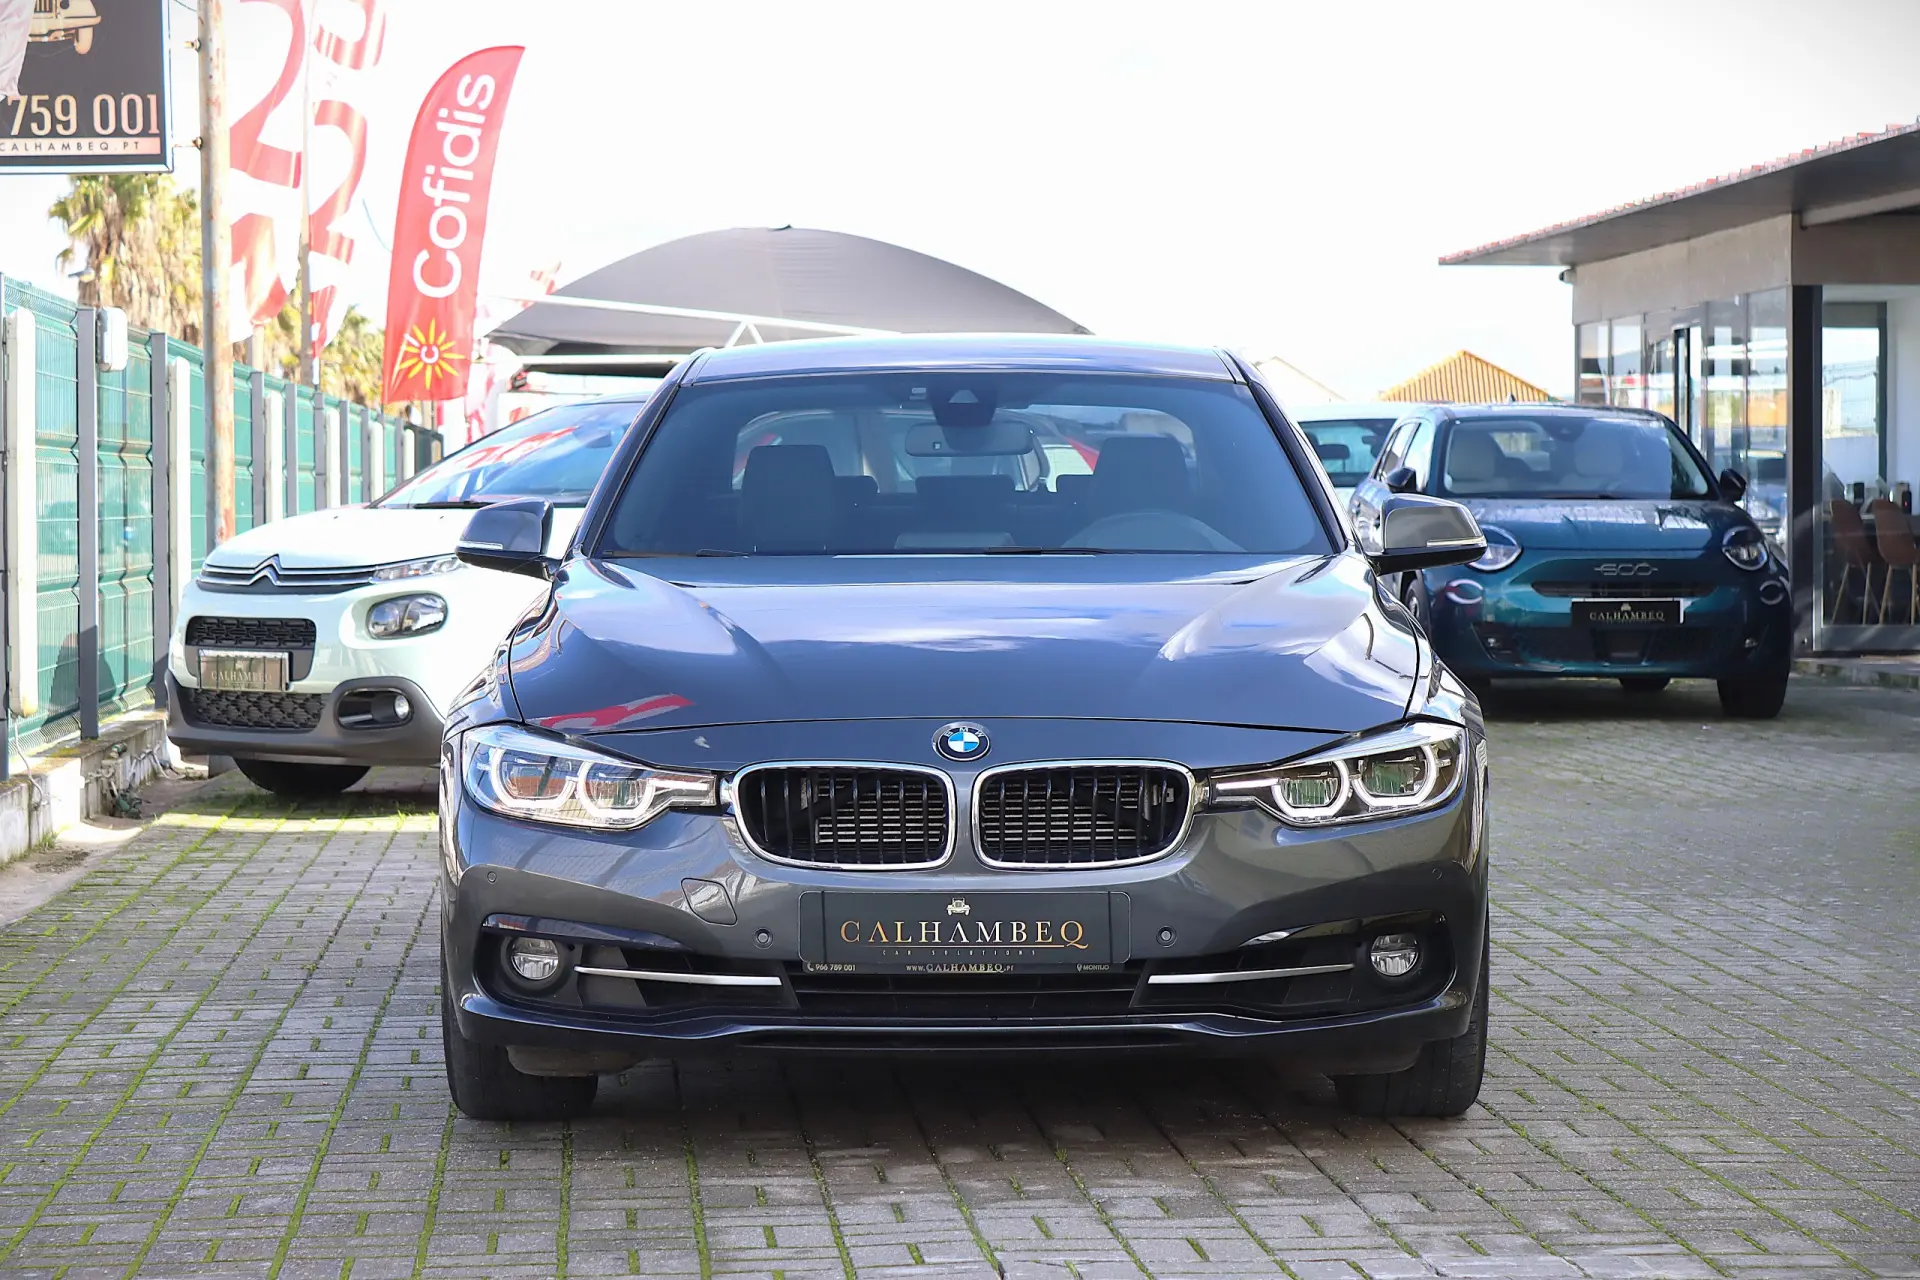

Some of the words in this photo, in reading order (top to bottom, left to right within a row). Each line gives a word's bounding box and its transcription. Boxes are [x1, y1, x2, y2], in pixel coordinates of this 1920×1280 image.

[7, 94, 78, 136] 759
[93, 93, 160, 135] 001
[412, 73, 496, 299] Cofidis
[1589, 611, 1665, 622] CALHAMBEQ
[943, 726, 986, 738] BMW
[840, 920, 1089, 949] CALHAMBEQ
